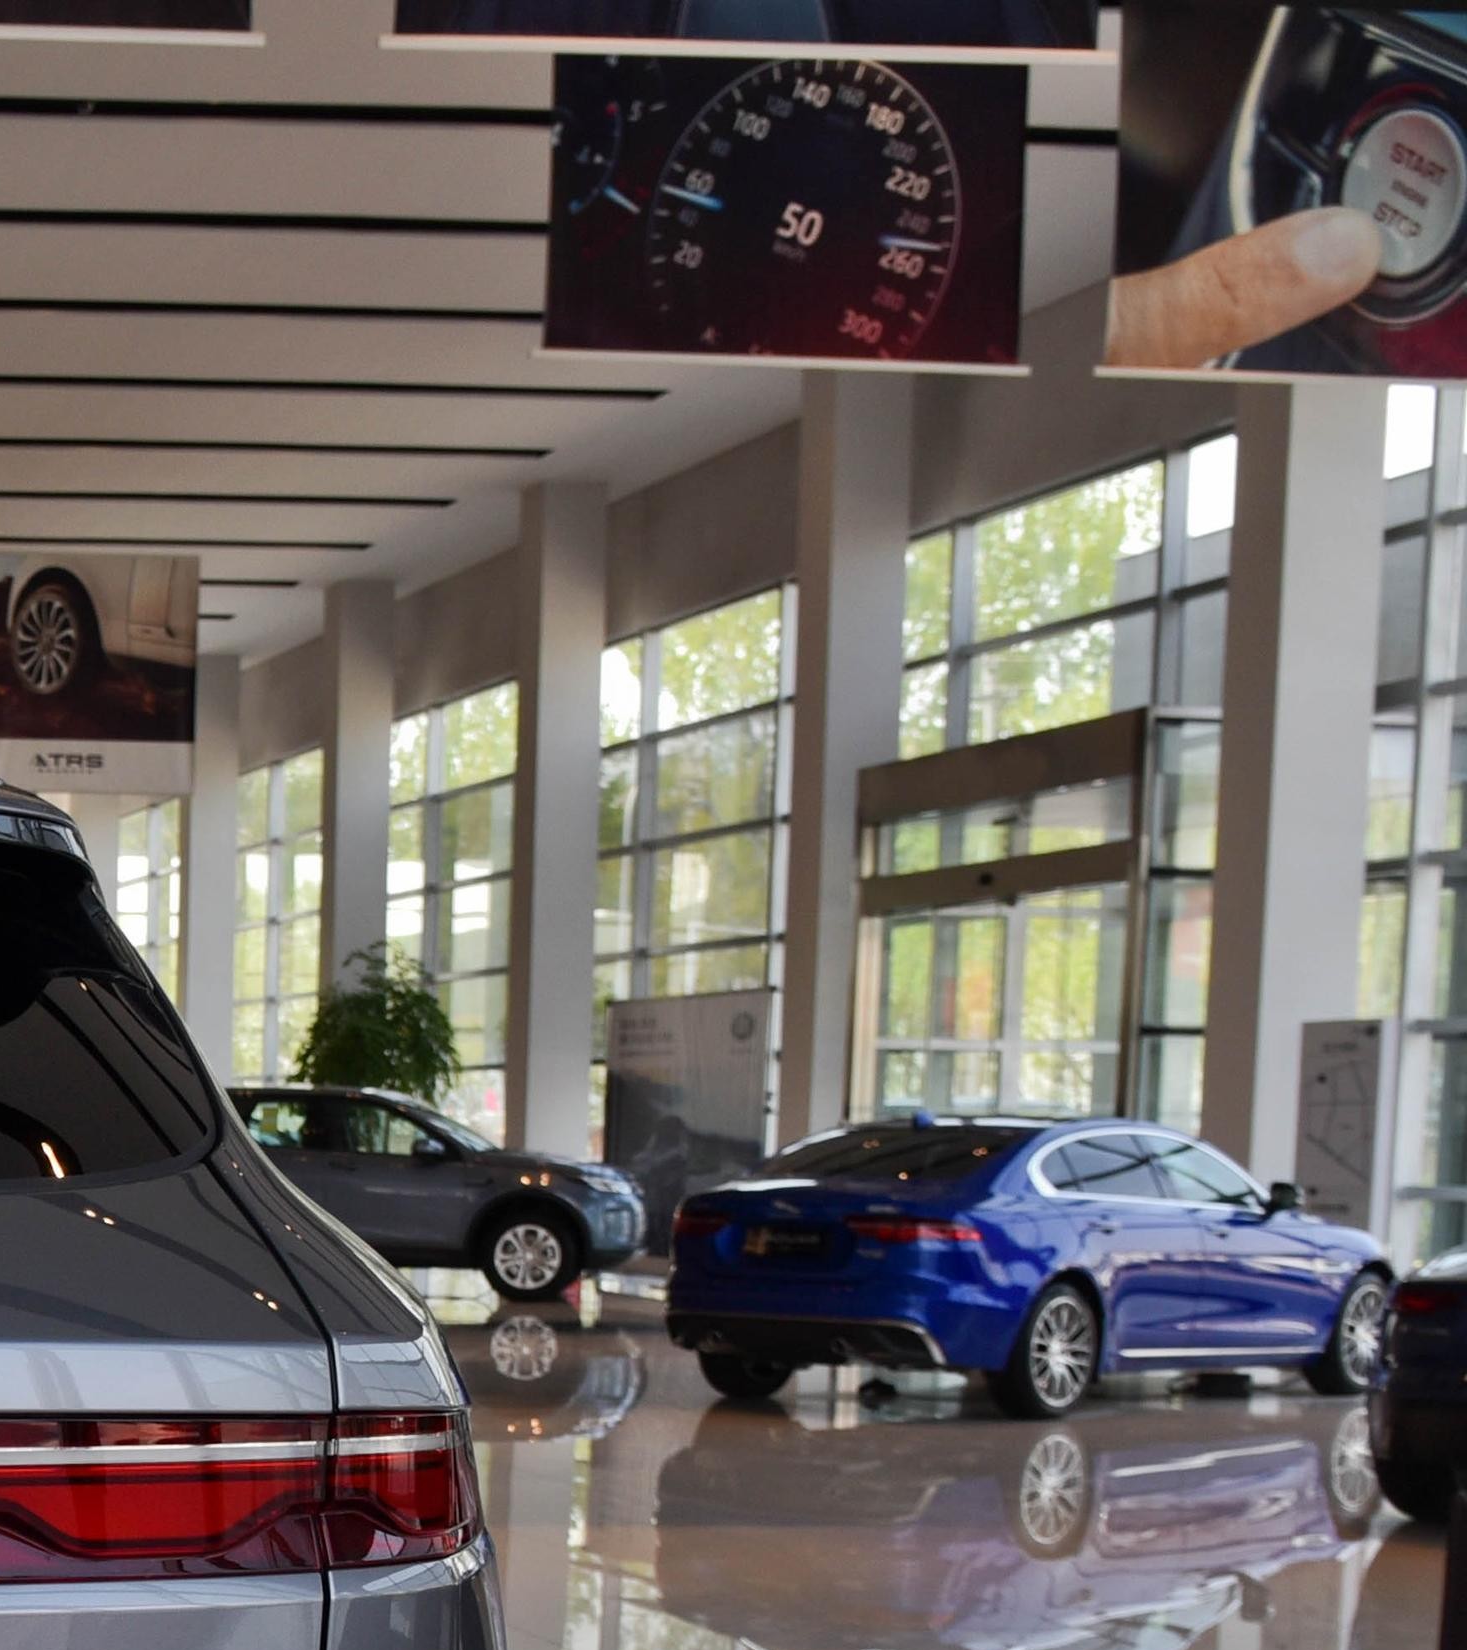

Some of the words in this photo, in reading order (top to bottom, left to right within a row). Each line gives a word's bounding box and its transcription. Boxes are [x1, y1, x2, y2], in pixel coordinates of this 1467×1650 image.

[794, 77, 830, 107] 140
[734, 110, 769, 139] 100
[868, 103, 903, 133] 180
[1392, 142, 1446, 185] START
[887, 167, 930, 199] 220
[777, 203, 822, 245] 50
[675, 241, 702, 268] 20
[880, 248, 923, 278] 260
[839, 309, 881, 342] 300
